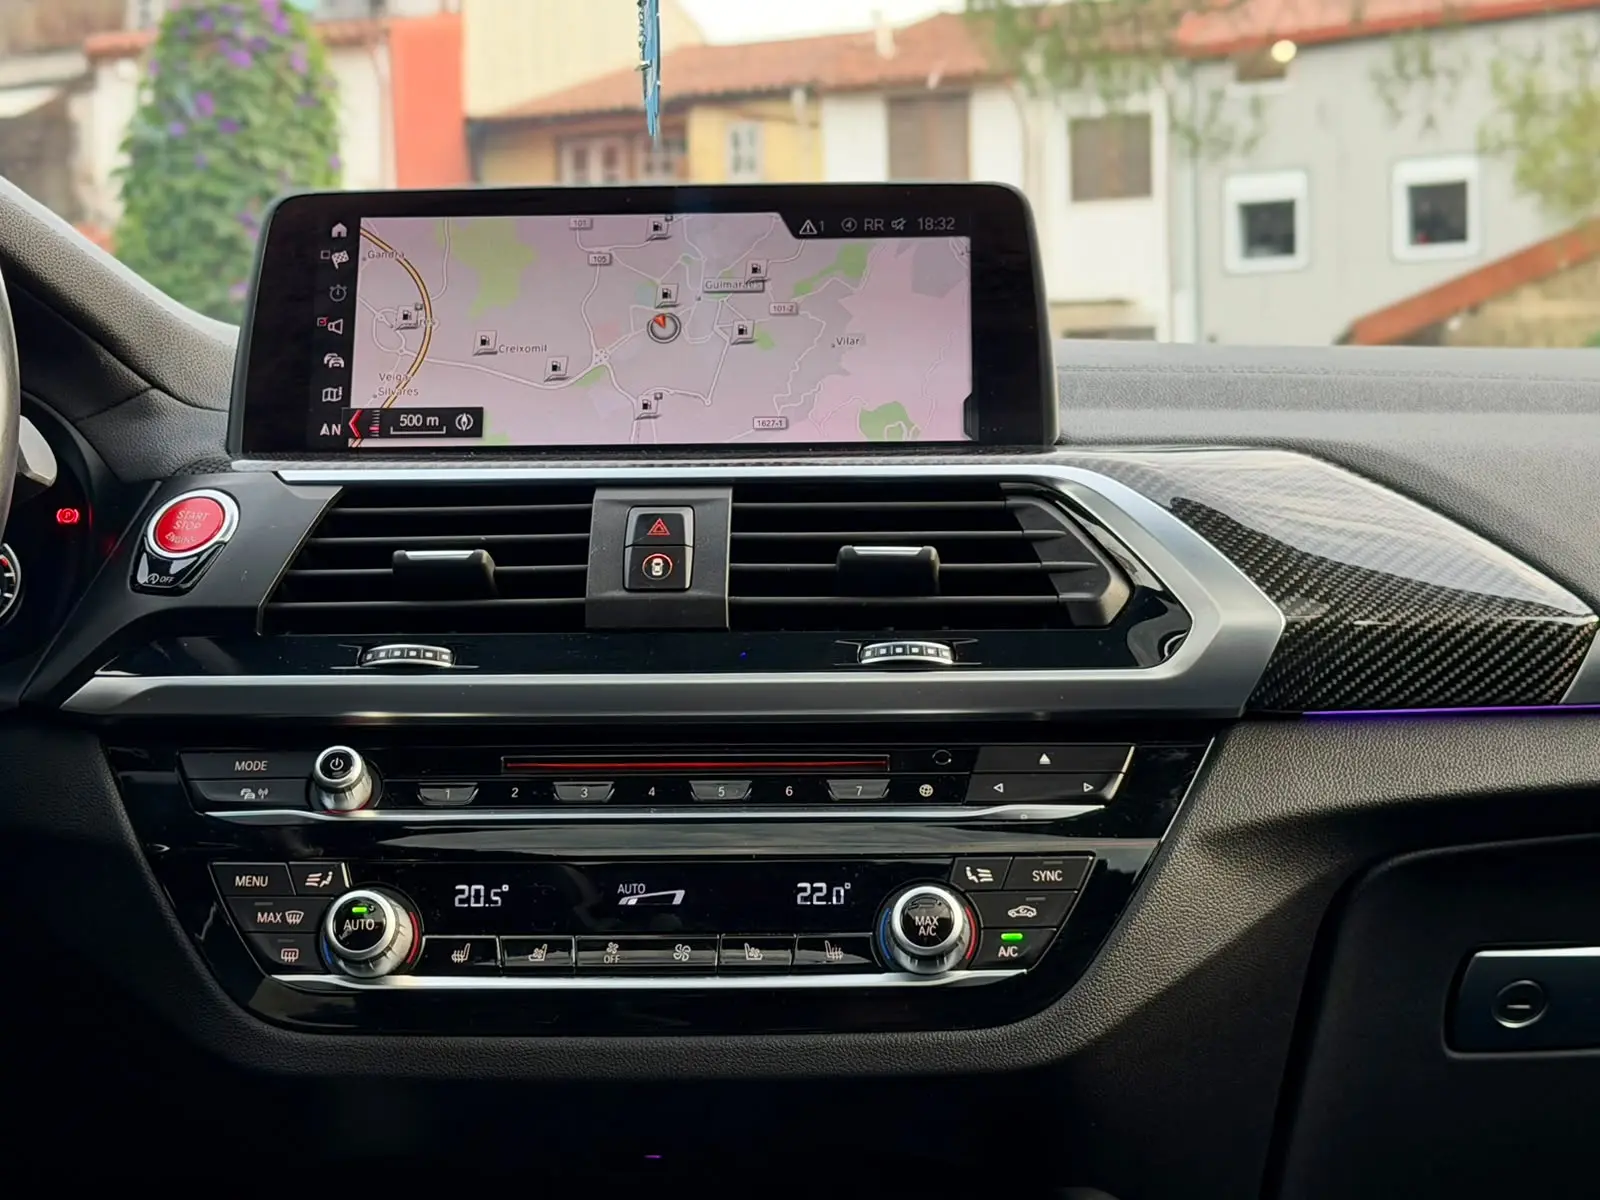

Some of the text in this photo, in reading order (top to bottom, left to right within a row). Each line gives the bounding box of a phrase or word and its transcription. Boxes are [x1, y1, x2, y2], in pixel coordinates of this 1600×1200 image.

[863, 218, 884, 231] RR
[917, 217, 955, 230] 18:32
[705, 280, 762, 290] Guimar
[836, 336, 860, 346] Vilar
[498, 343, 548, 354] Creixomil
[399, 414, 440, 427] 500 m
[160, 575, 176, 583] OFF
[234, 760, 268, 772] MODE
[445, 788, 451, 801] 1
[511, 787, 519, 798] 2
[580, 786, 589, 799] 3
[647, 785, 656, 797] 4
[717, 785, 726, 797] 5
[784, 785, 794, 797] 6
[855, 786, 863, 797] 7
[234, 874, 269, 888] MENU
[1031, 869, 1064, 883] SYNC
[617, 883, 646, 895] AUTO
[256, 911, 282, 924] MAX
[914, 915, 940, 926] MAX
[342, 918, 376, 931] AUTO
[918, 926, 938, 937] A/C
[998, 946, 1019, 958] A/C
[603, 954, 621, 964] OFF
